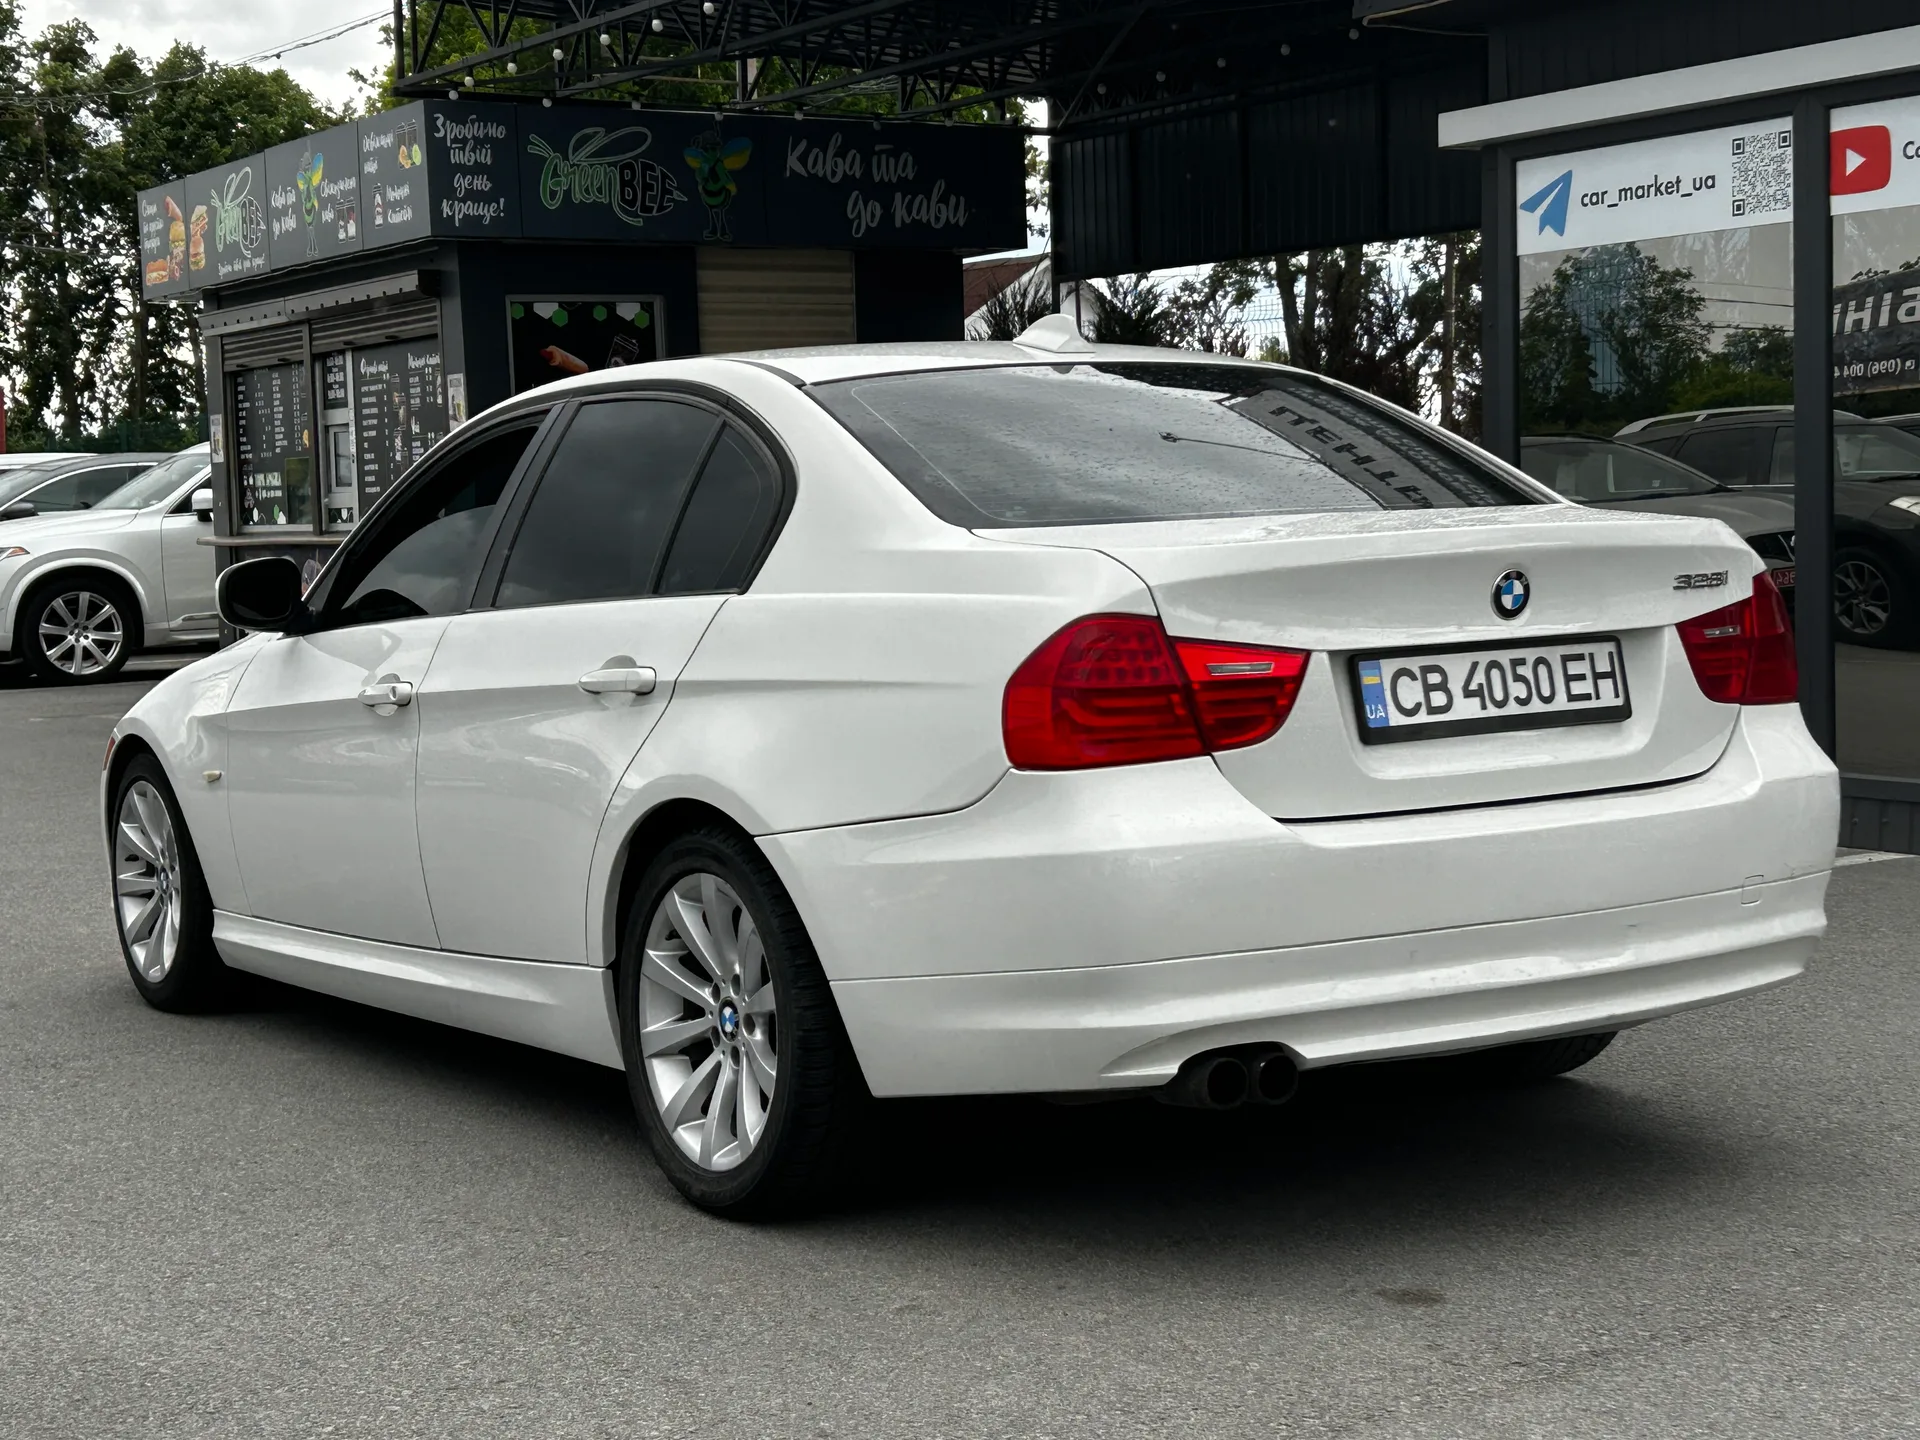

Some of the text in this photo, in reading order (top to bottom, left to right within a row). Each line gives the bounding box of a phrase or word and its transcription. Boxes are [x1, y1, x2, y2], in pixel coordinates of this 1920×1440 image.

[433, 113, 507, 147] Зробимо
[450, 140, 493, 166] твій
[785, 132, 918, 184] Кава та
[453, 172, 493, 198] день
[1580, 174, 1716, 208] car_market_ua
[441, 198, 505, 227] краще!
[846, 179, 969, 238] до кави
[1673, 570, 1729, 591] 328i
[1389, 650, 1621, 718] CB 4050 EH
[1366, 703, 1386, 719] UA
